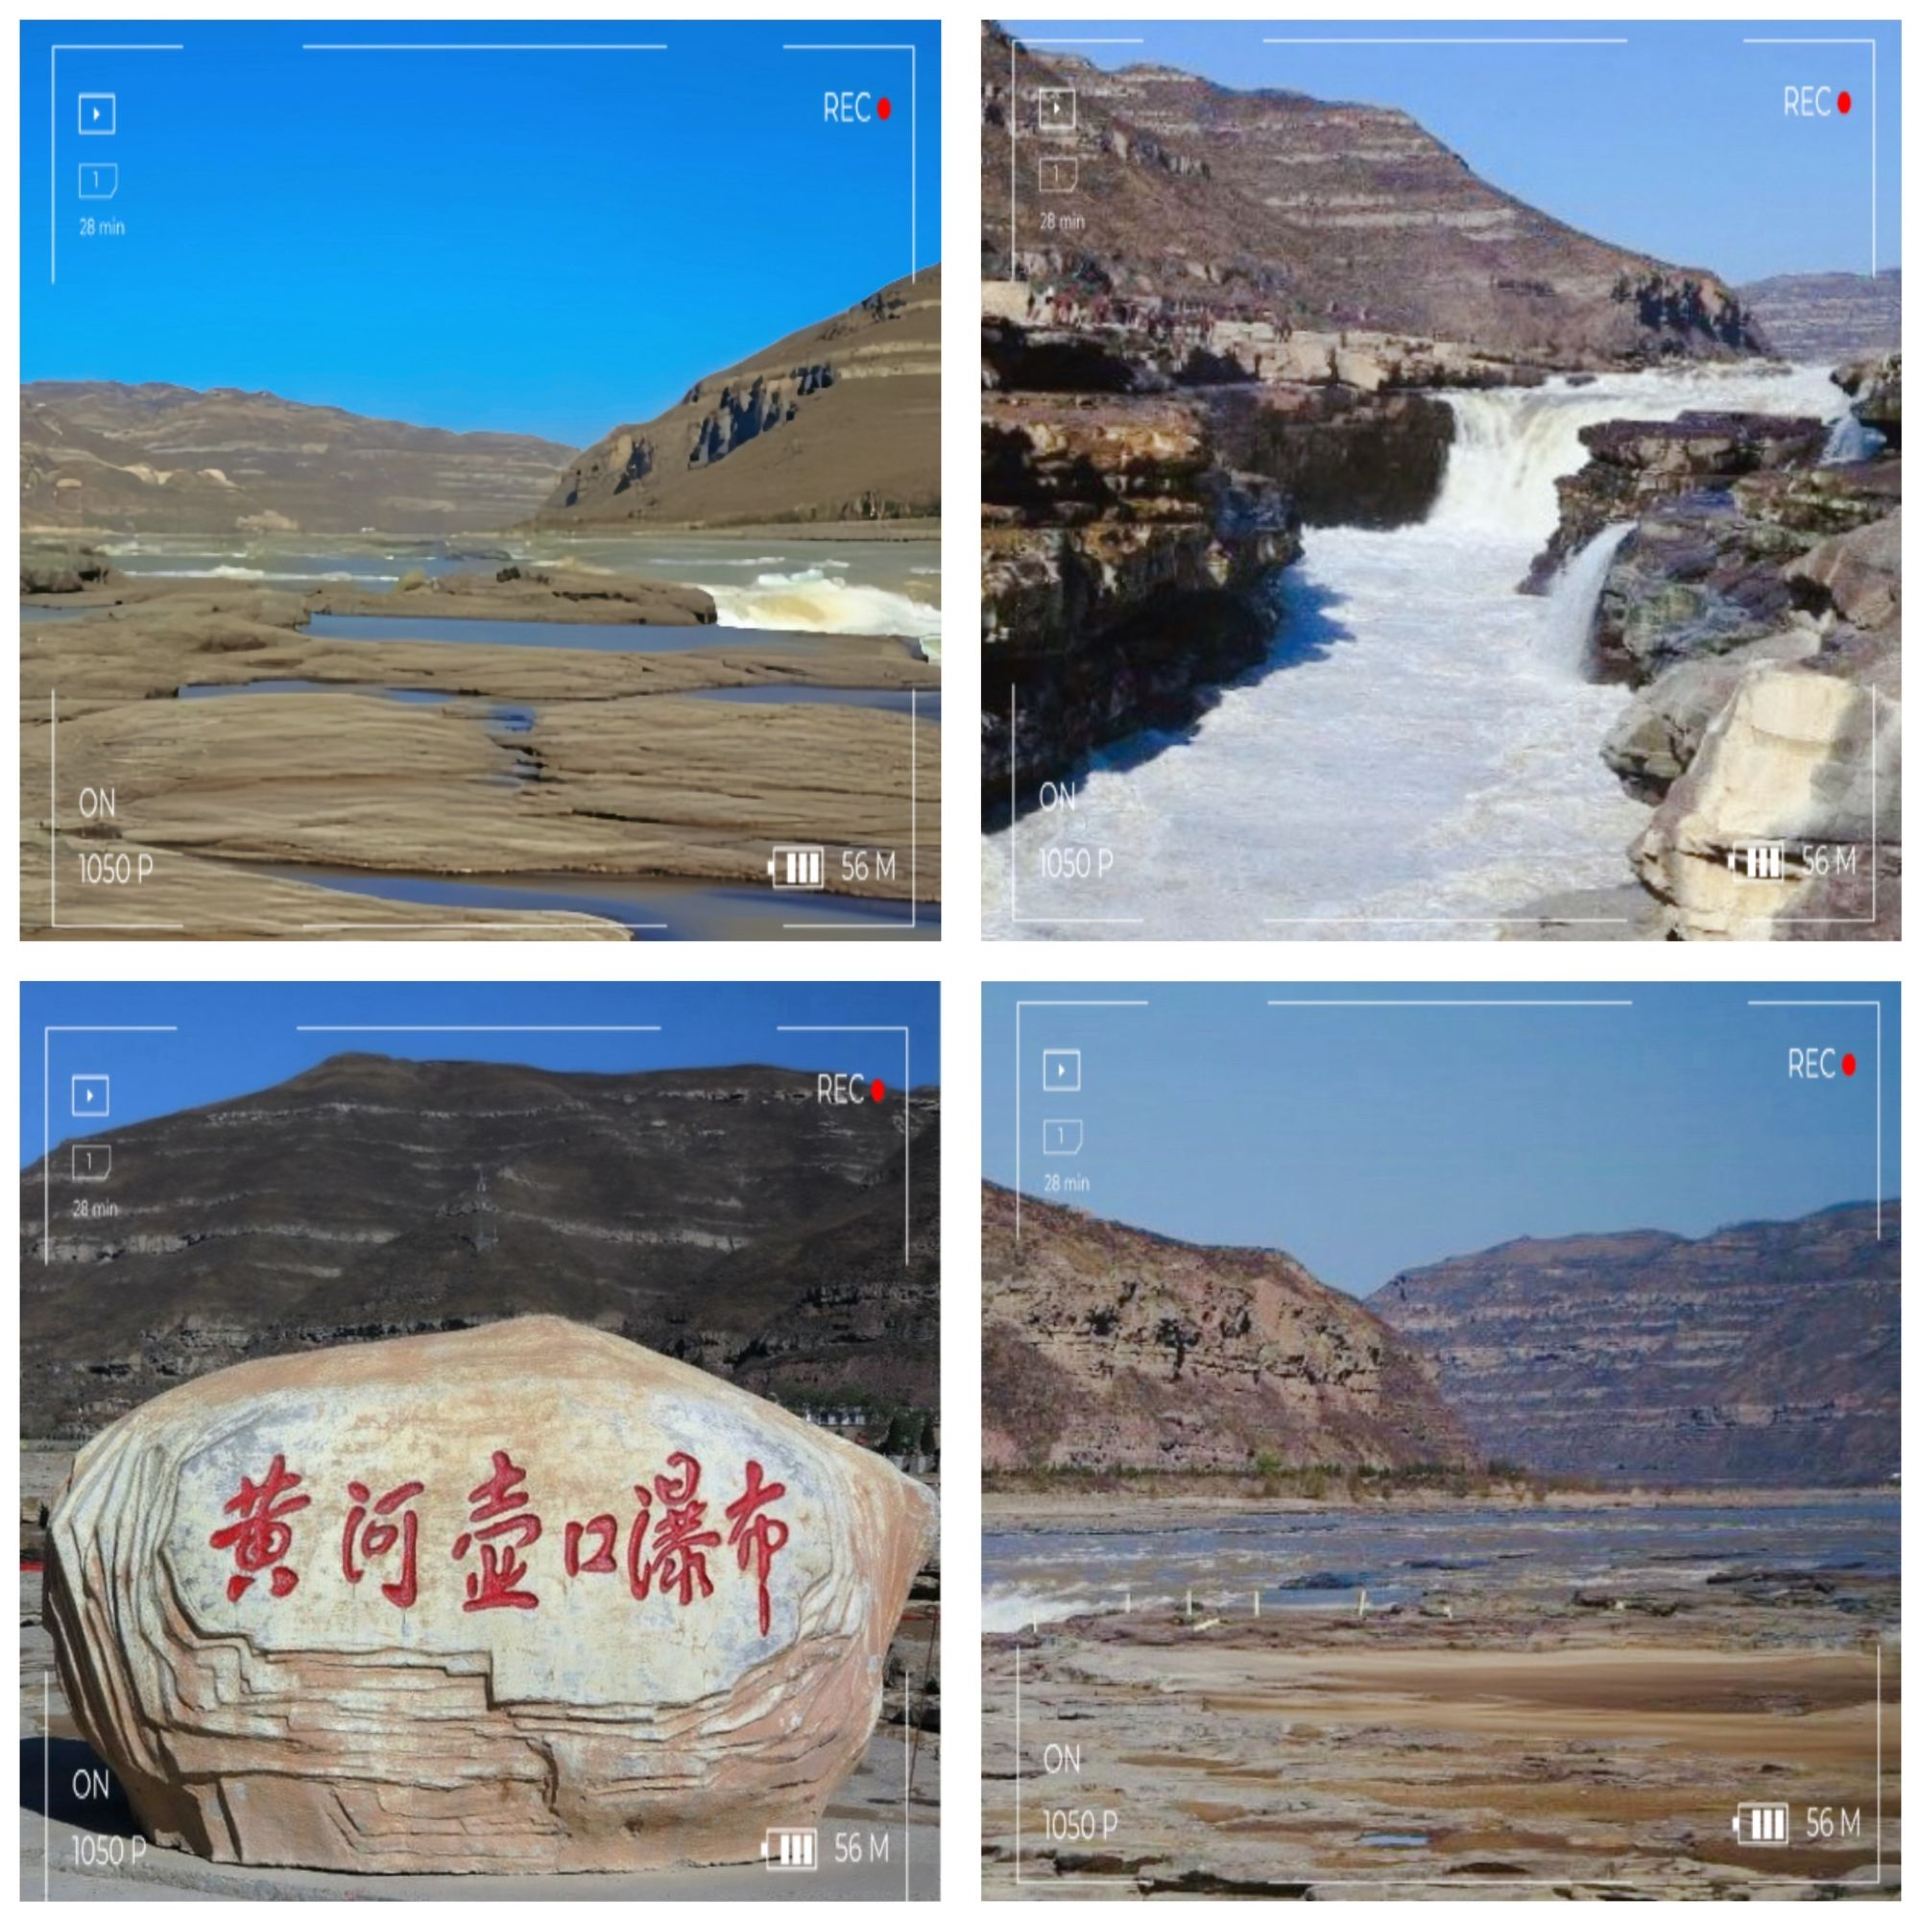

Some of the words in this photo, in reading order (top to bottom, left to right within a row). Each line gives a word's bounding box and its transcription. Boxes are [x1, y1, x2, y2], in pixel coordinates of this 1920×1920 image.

[210, 1450, 789, 1636] 黄河壶口瀑布
